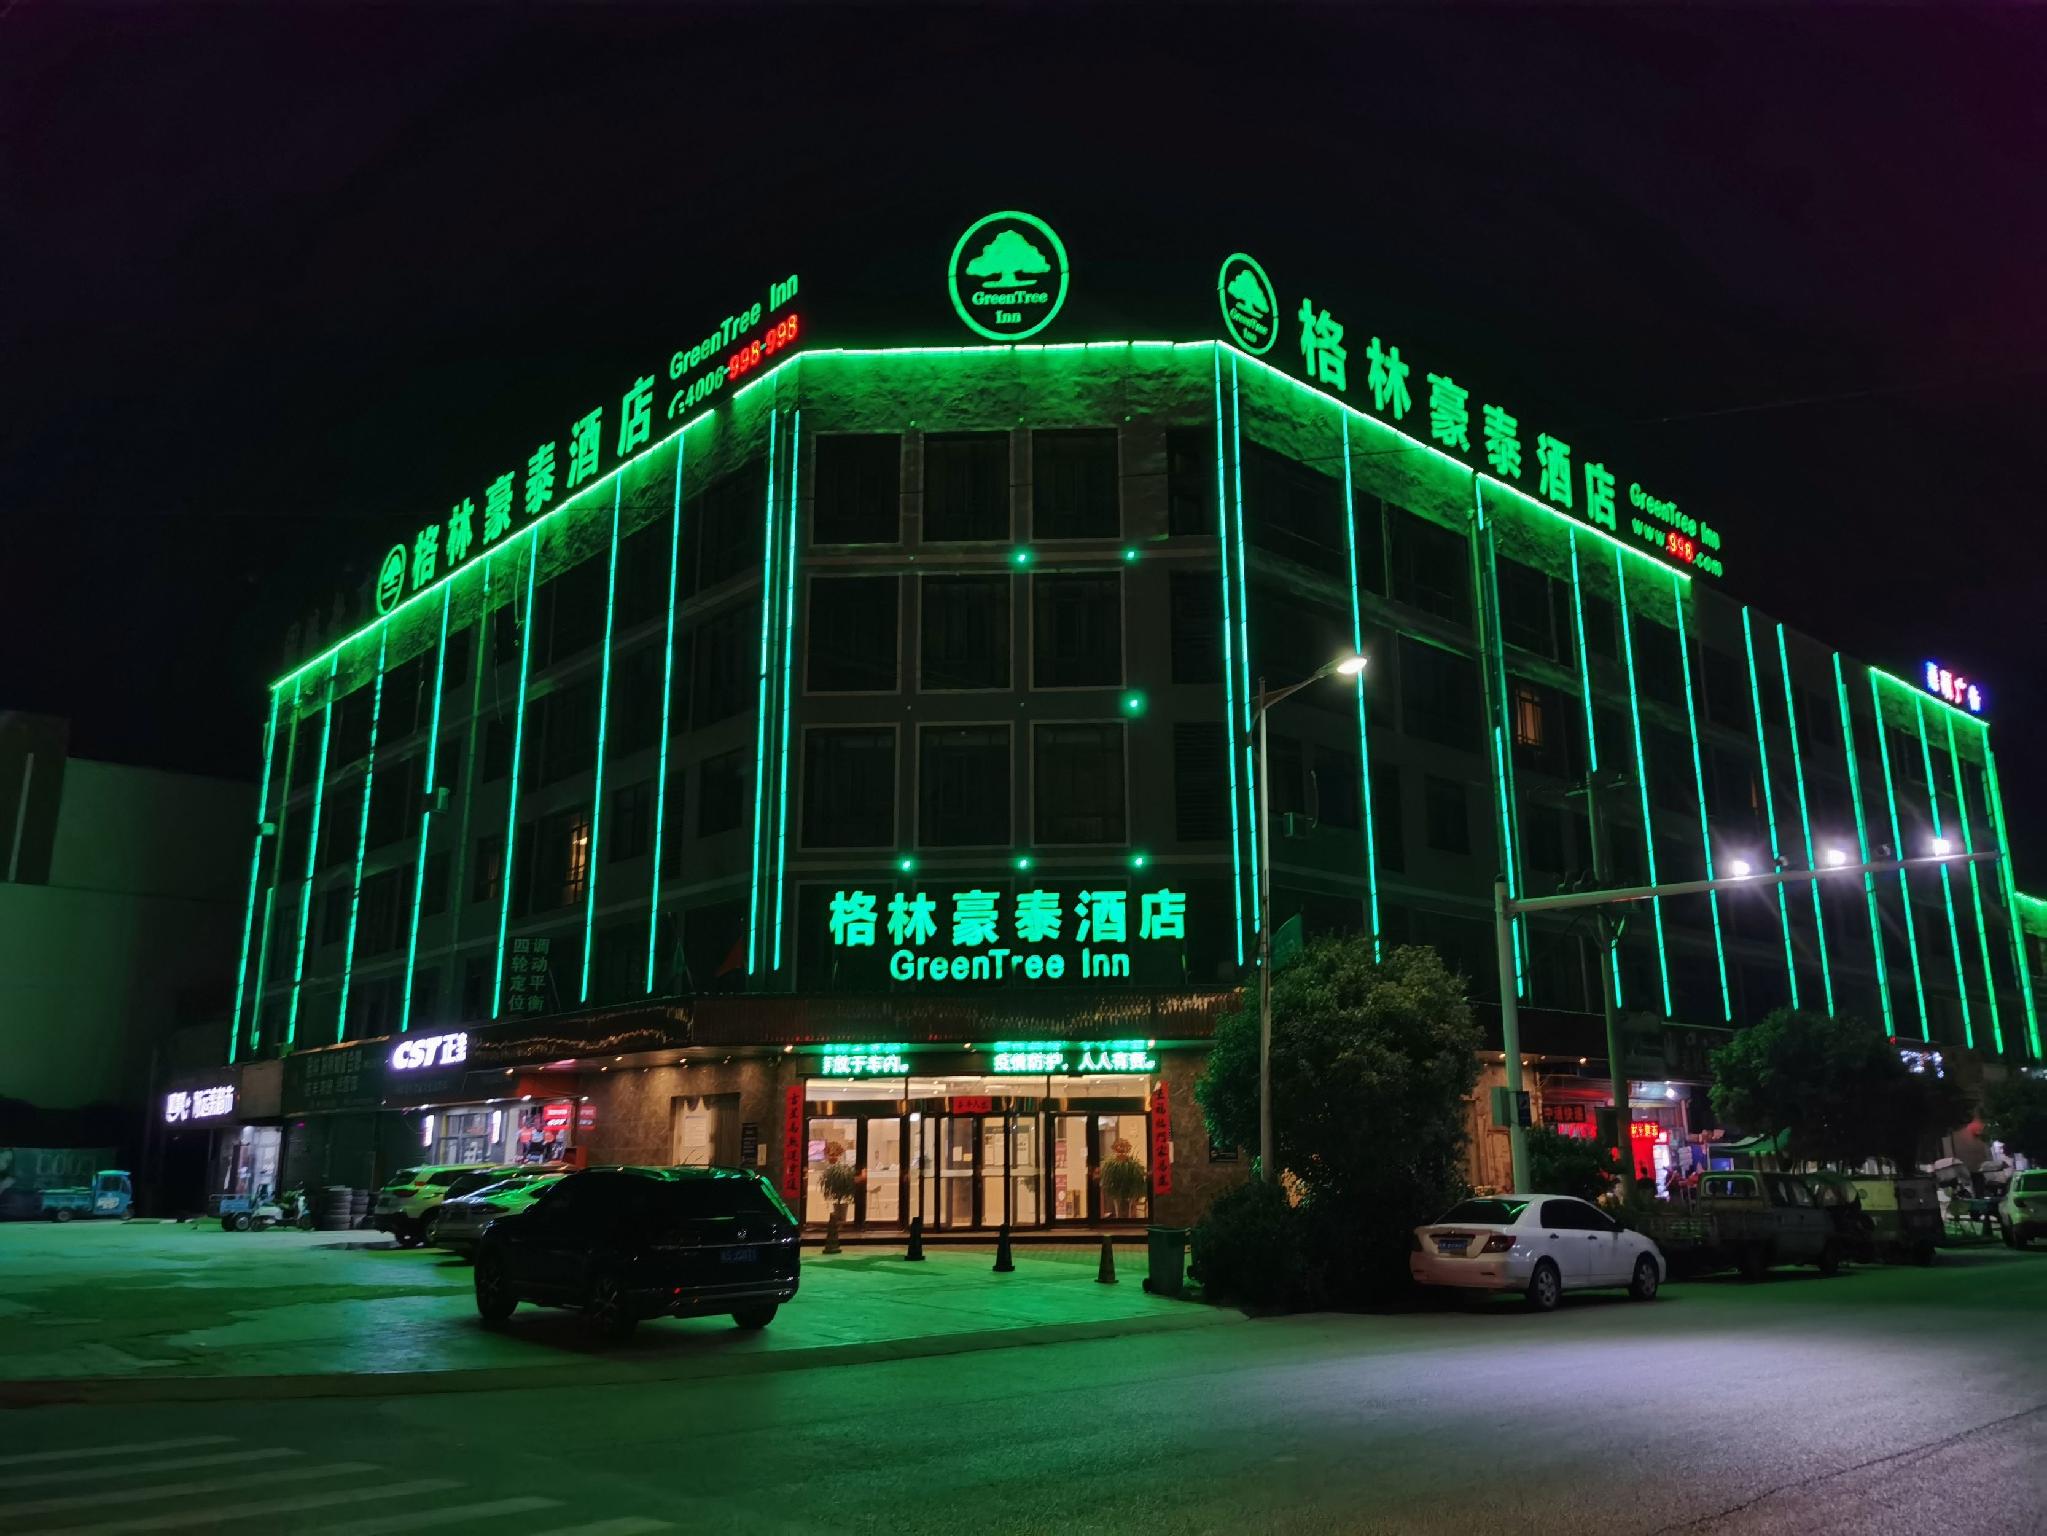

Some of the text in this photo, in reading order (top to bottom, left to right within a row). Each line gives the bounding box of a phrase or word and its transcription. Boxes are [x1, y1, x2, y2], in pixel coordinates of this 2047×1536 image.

[670, 275, 798, 380] GreenTree Inn
[971, 291, 1049, 306] GreenTree
[995, 309, 1023, 324] Inn
[685, 314, 799, 408] 4006-998-998
[1298, 298, 1617, 532] 格林豪泰酒店
[412, 374, 655, 592] 格林豪泰酒店
[1629, 481, 1721, 552] GreenTree Inn
[1631, 516, 1723, 578] www.998.com
[829, 887, 1187, 946] 格林豪泰酒店
[889, 948, 1130, 982] GreenTree Inn
